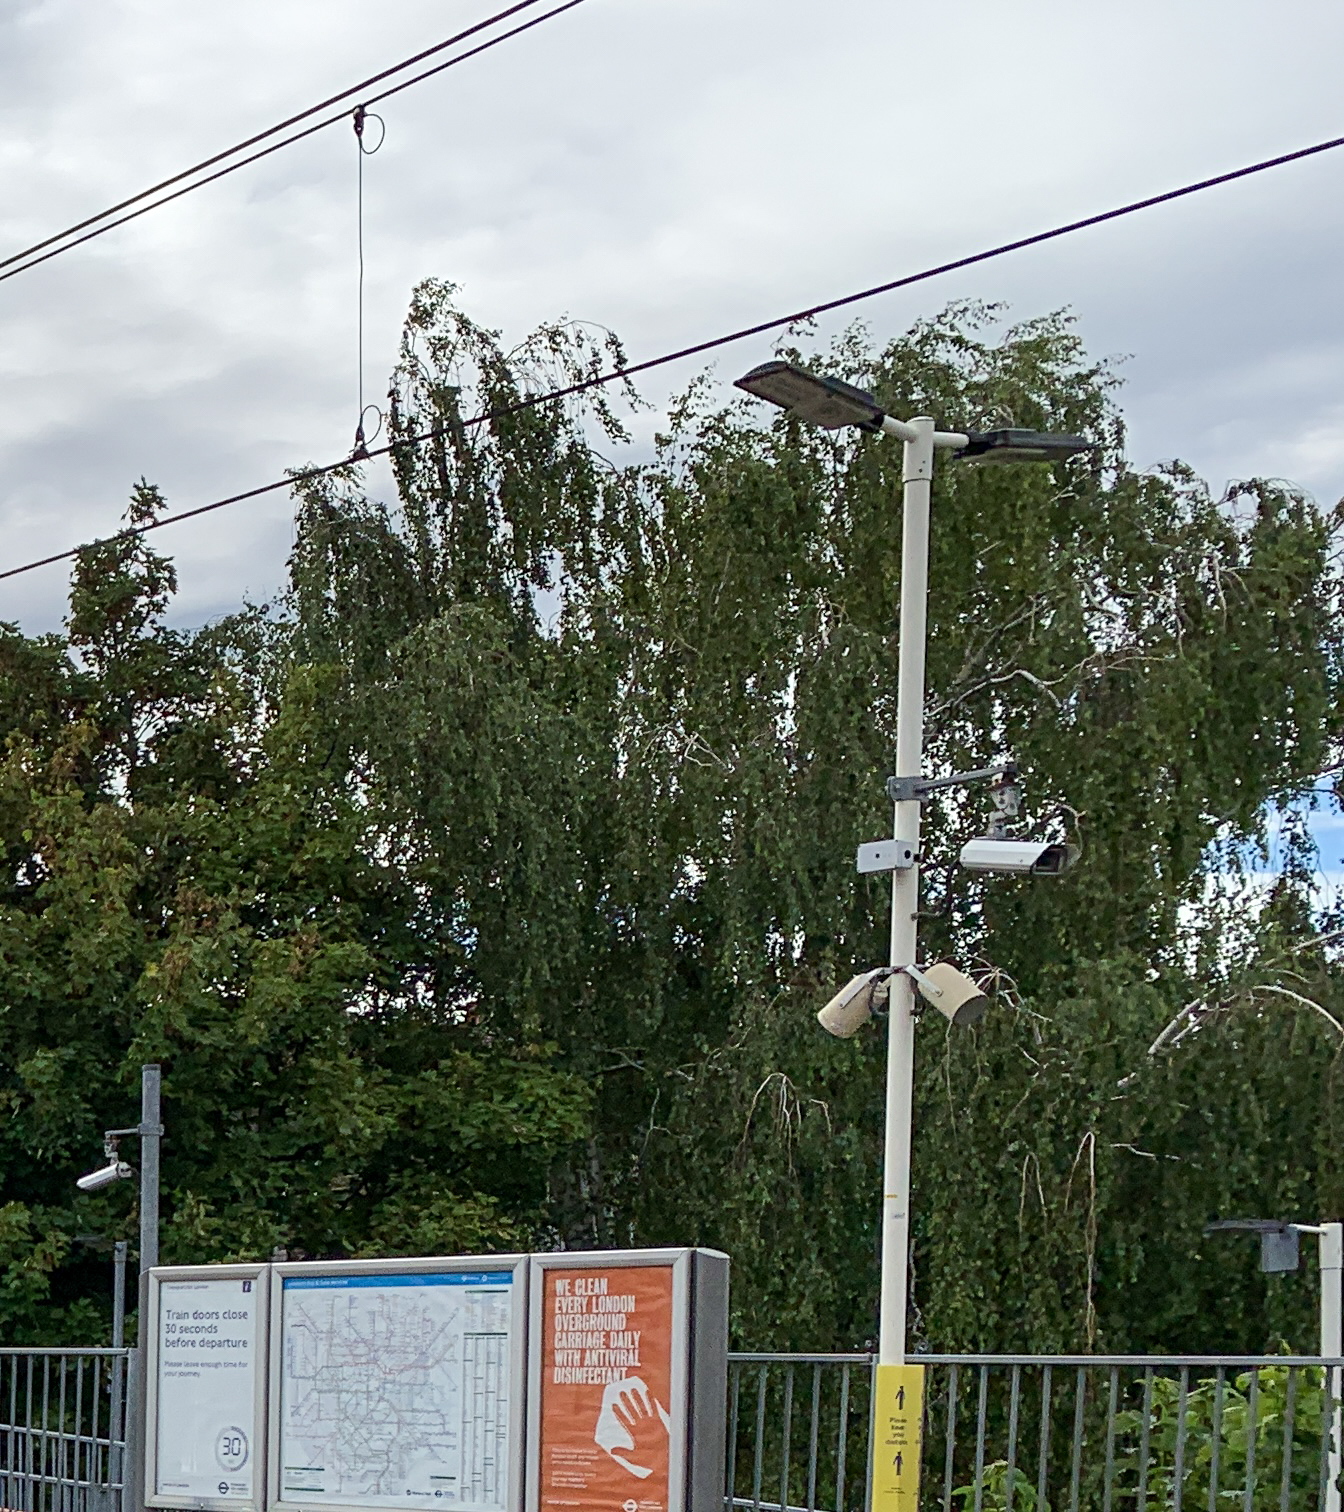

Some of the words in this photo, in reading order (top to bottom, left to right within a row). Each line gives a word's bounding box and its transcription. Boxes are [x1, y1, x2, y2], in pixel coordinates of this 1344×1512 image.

[555, 1279, 571, 1296] WE
[574, 1278, 608, 1296] CLEAN
[555, 1296, 589, 1313] EVERY
[592, 1295, 635, 1313] LONDON
[166, 1310, 190, 1320] Train
[192, 1310, 220, 1320] doors
[222, 1309, 249, 1320] close
[554, 1314, 626, 1332] OVERGROUND
[165, 1323, 177, 1334] 30
[179, 1324, 218, 1334] seconds
[165, 1337, 197, 1348] before
[199, 1337, 248, 1349] departure
[554, 1331, 606, 1349] CARRIAGE
[609, 1330, 641, 1349] DAILY
[200, 1361, 222, 1369] enough
[554, 1349, 581, 1367] WITH
[583, 1348, 642, 1367] ANTIVIRAL
[553, 1367, 627, 1384] DISINFECTANT
[222, 1437, 242, 1457] 30
